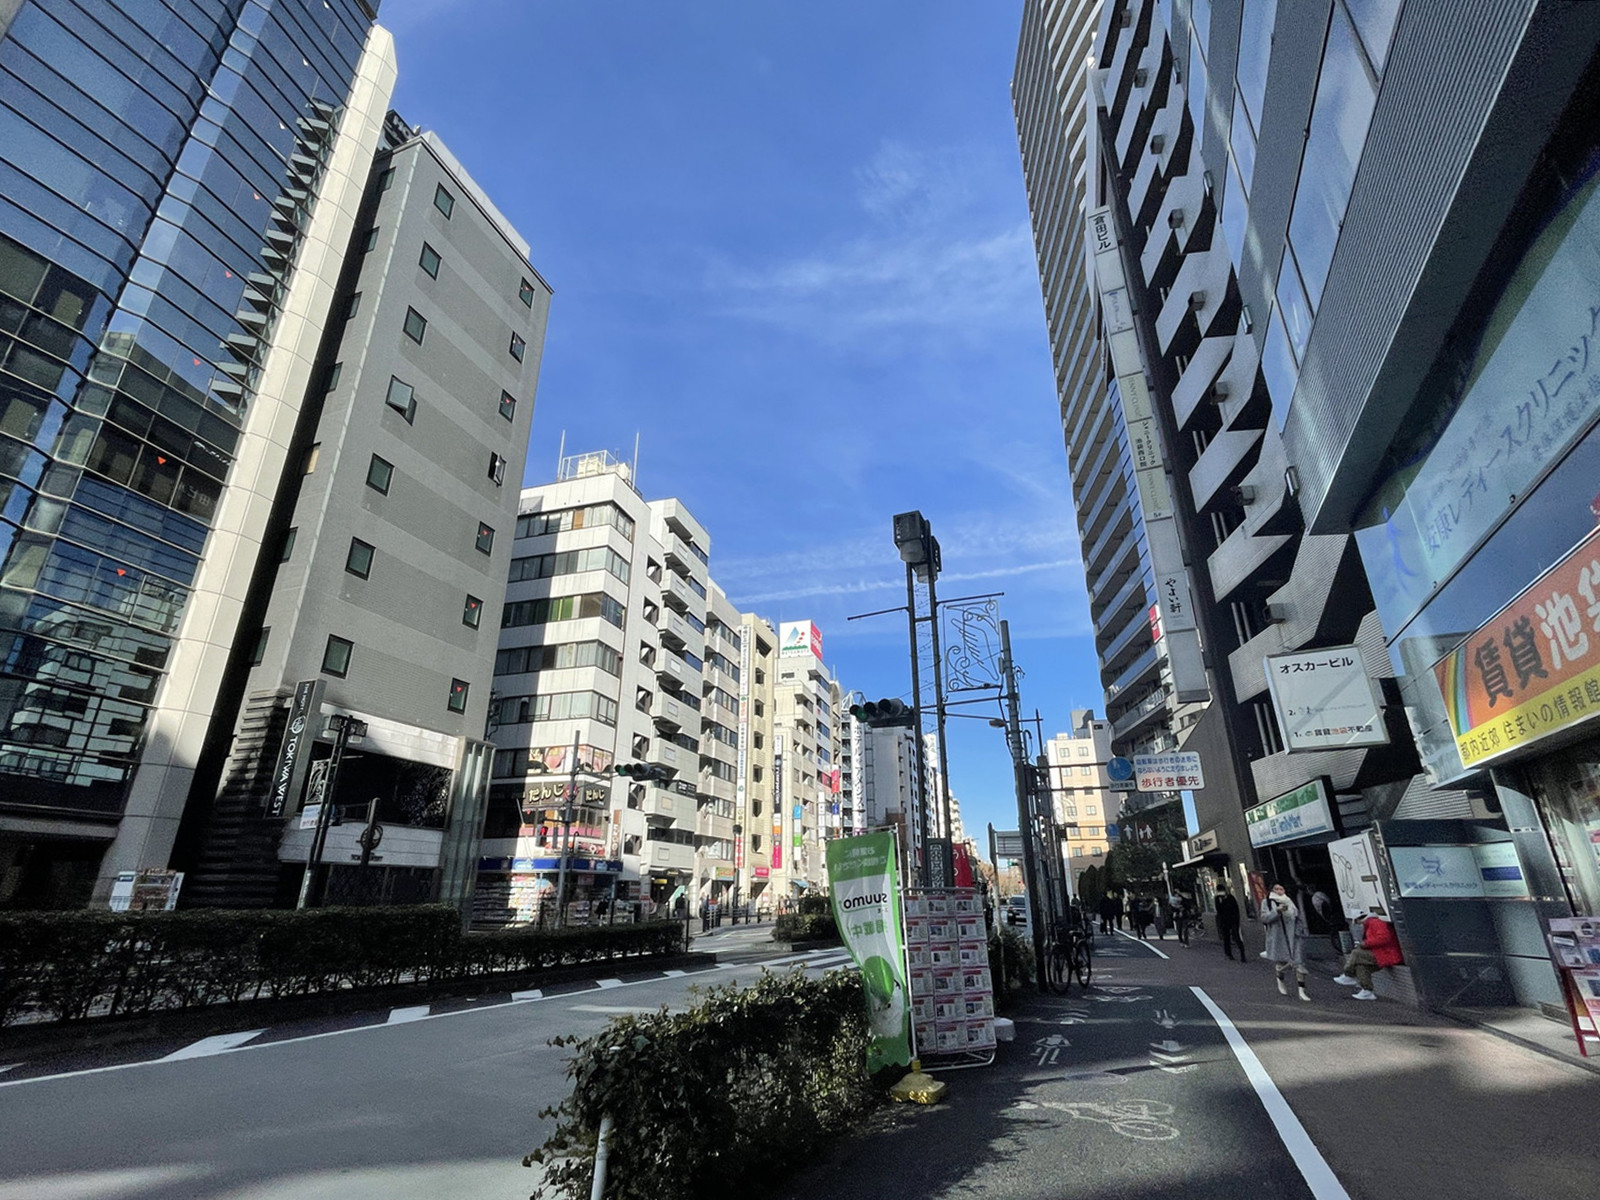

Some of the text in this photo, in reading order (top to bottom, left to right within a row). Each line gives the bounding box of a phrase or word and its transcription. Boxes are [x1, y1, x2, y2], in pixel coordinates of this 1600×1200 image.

[1165, 577, 1182, 613] やよい軒
[1280, 656, 1354, 674] オスカービル
[271, 735, 299, 817] TOKIWA WEST
[1141, 775, 1199, 788] 歩行者優先
